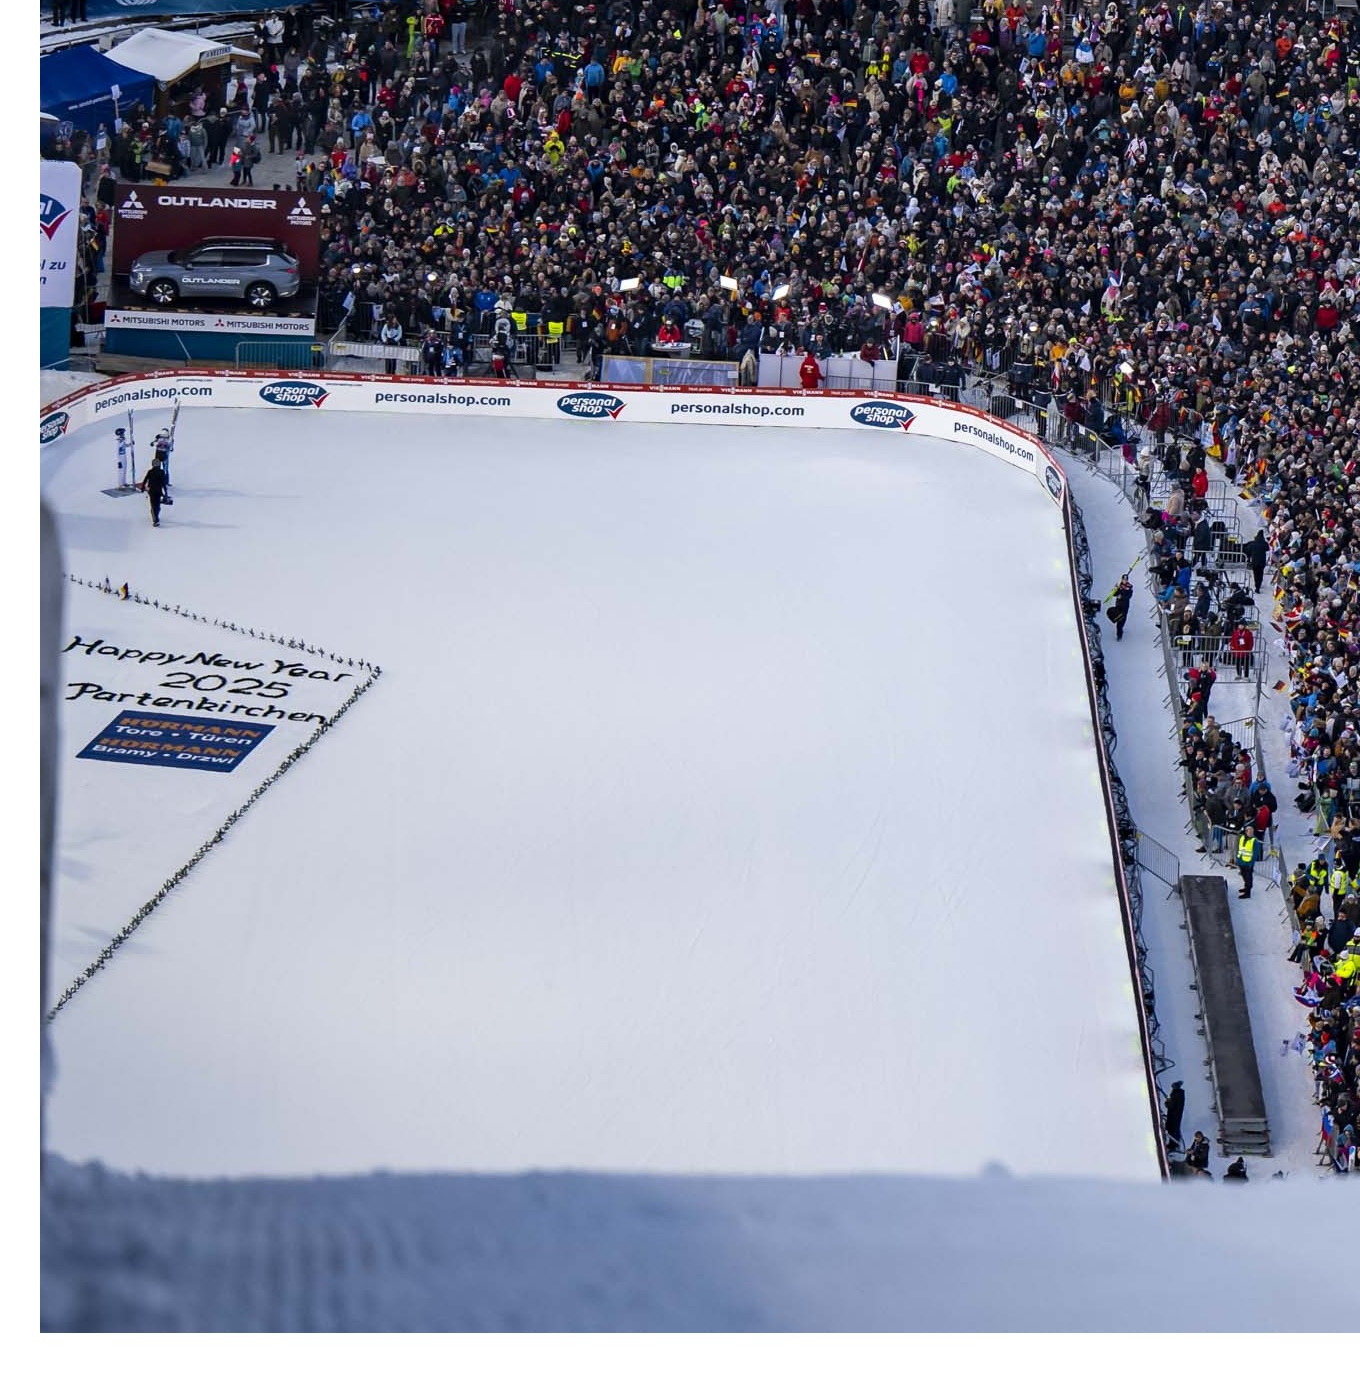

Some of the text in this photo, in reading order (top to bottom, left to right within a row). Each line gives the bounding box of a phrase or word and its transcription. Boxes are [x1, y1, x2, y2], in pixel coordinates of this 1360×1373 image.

[158, 195, 278, 210] OUTLANDER
[49, 260, 67, 271] zu
[182, 276, 240, 285] OUTLANDER
[122, 316, 310, 331] MITSUBISHI MOTORS MITSUBISHI MOTORS
[263, 385, 320, 396] personal
[95, 386, 213, 413] personalshop.com
[274, 393, 306, 404] shop
[375, 392, 511, 407] personalshop.com
[560, 397, 617, 407] personal
[572, 404, 603, 415] shop
[671, 403, 805, 417] personalshop.com
[854, 406, 907, 418] personal
[865, 414, 894, 425] shop
[953, 422, 1034, 463] personalshop.com
[61, 635, 353, 683] Happy New Year
[158, 672, 293, 699] 2025
[65, 682, 326, 726] Partenkirchen
[115, 726, 253, 746] Tore Türen
[92, 744, 236, 764] Bramy Drzwi
